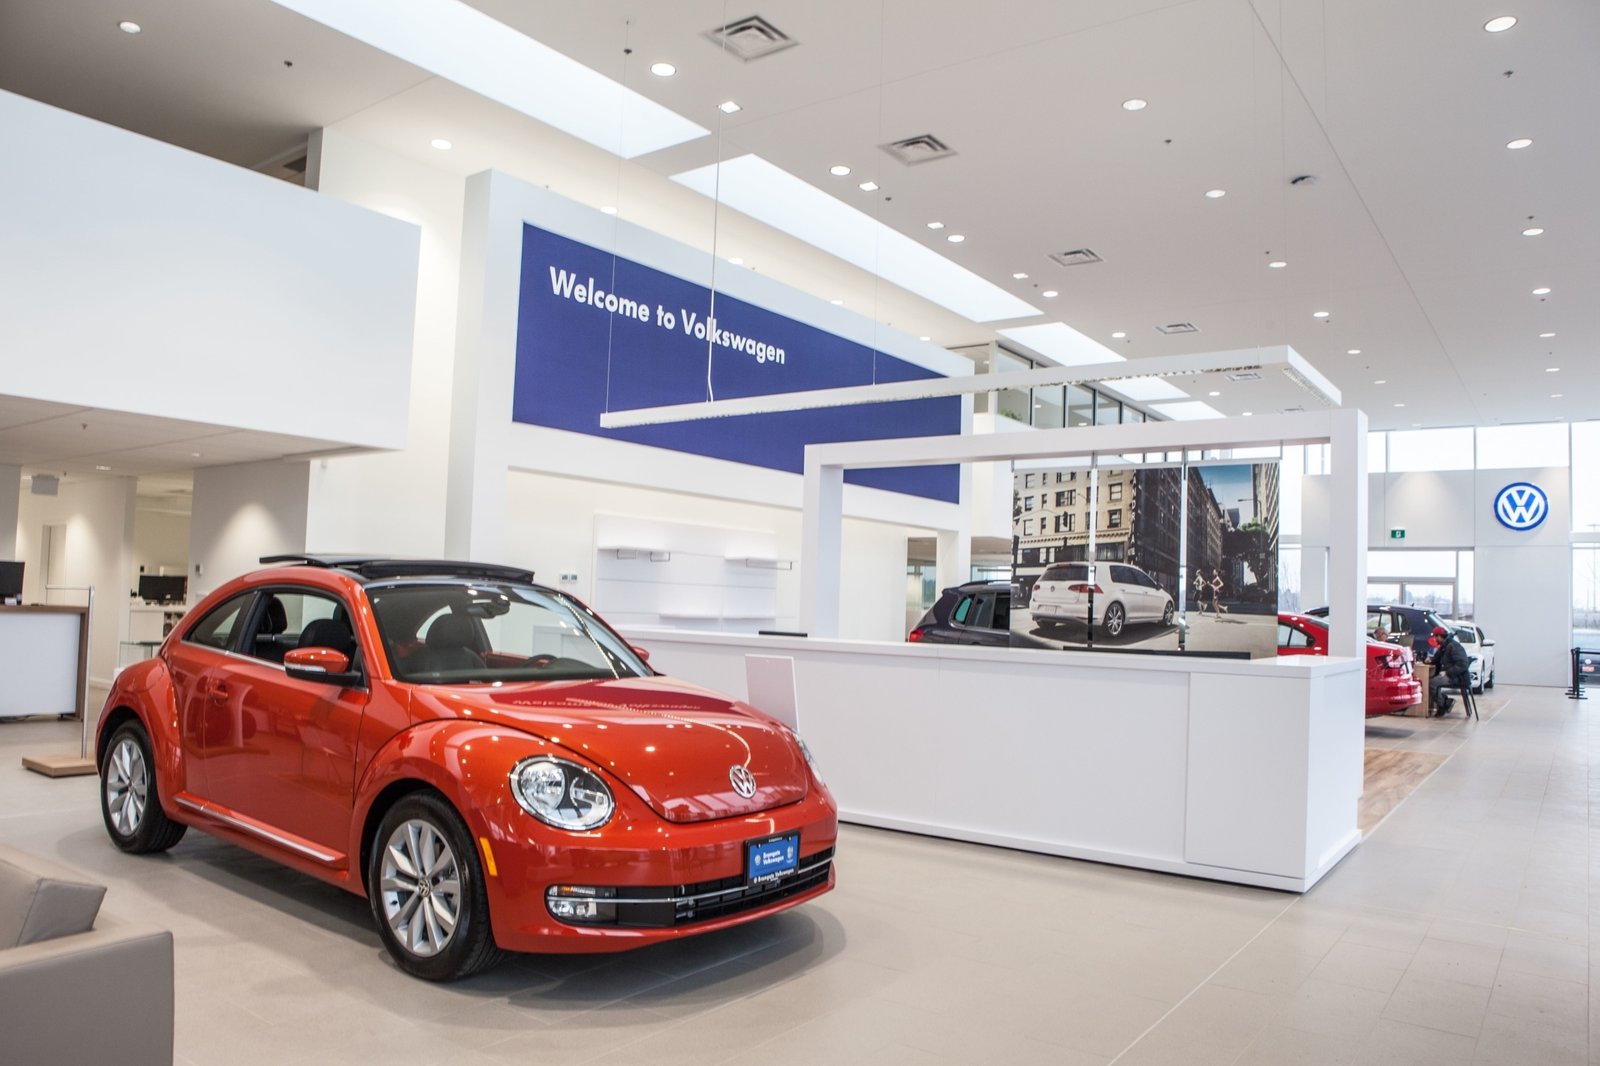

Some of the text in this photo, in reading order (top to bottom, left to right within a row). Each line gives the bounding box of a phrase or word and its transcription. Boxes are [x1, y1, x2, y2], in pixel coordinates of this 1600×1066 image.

[549, 265, 786, 365] Welcome to Volkswagen
[1497, 485, 1545, 528] VW
[731, 766, 755, 797] VW
